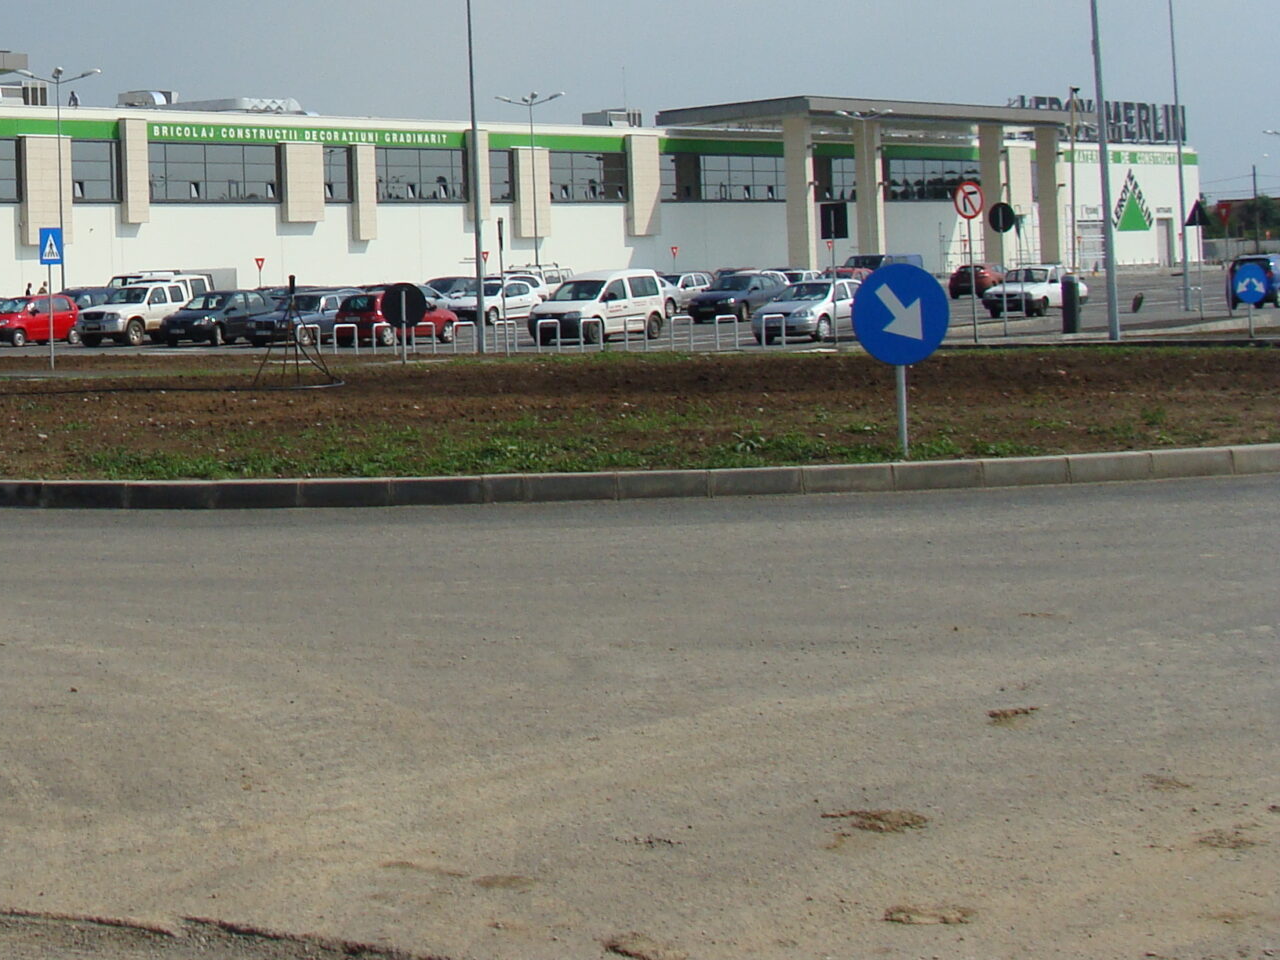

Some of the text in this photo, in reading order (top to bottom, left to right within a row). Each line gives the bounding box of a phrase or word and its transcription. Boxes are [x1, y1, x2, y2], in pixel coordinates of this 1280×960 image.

[153, 125, 214, 138] BRICOLAJ
[221, 128, 298, 140] CONSTRUCTII
[385, 132, 447, 144] GRADINARIT
[1104, 100, 1186, 143] MERLIN
[1127, 168, 1154, 216] MERLIN
